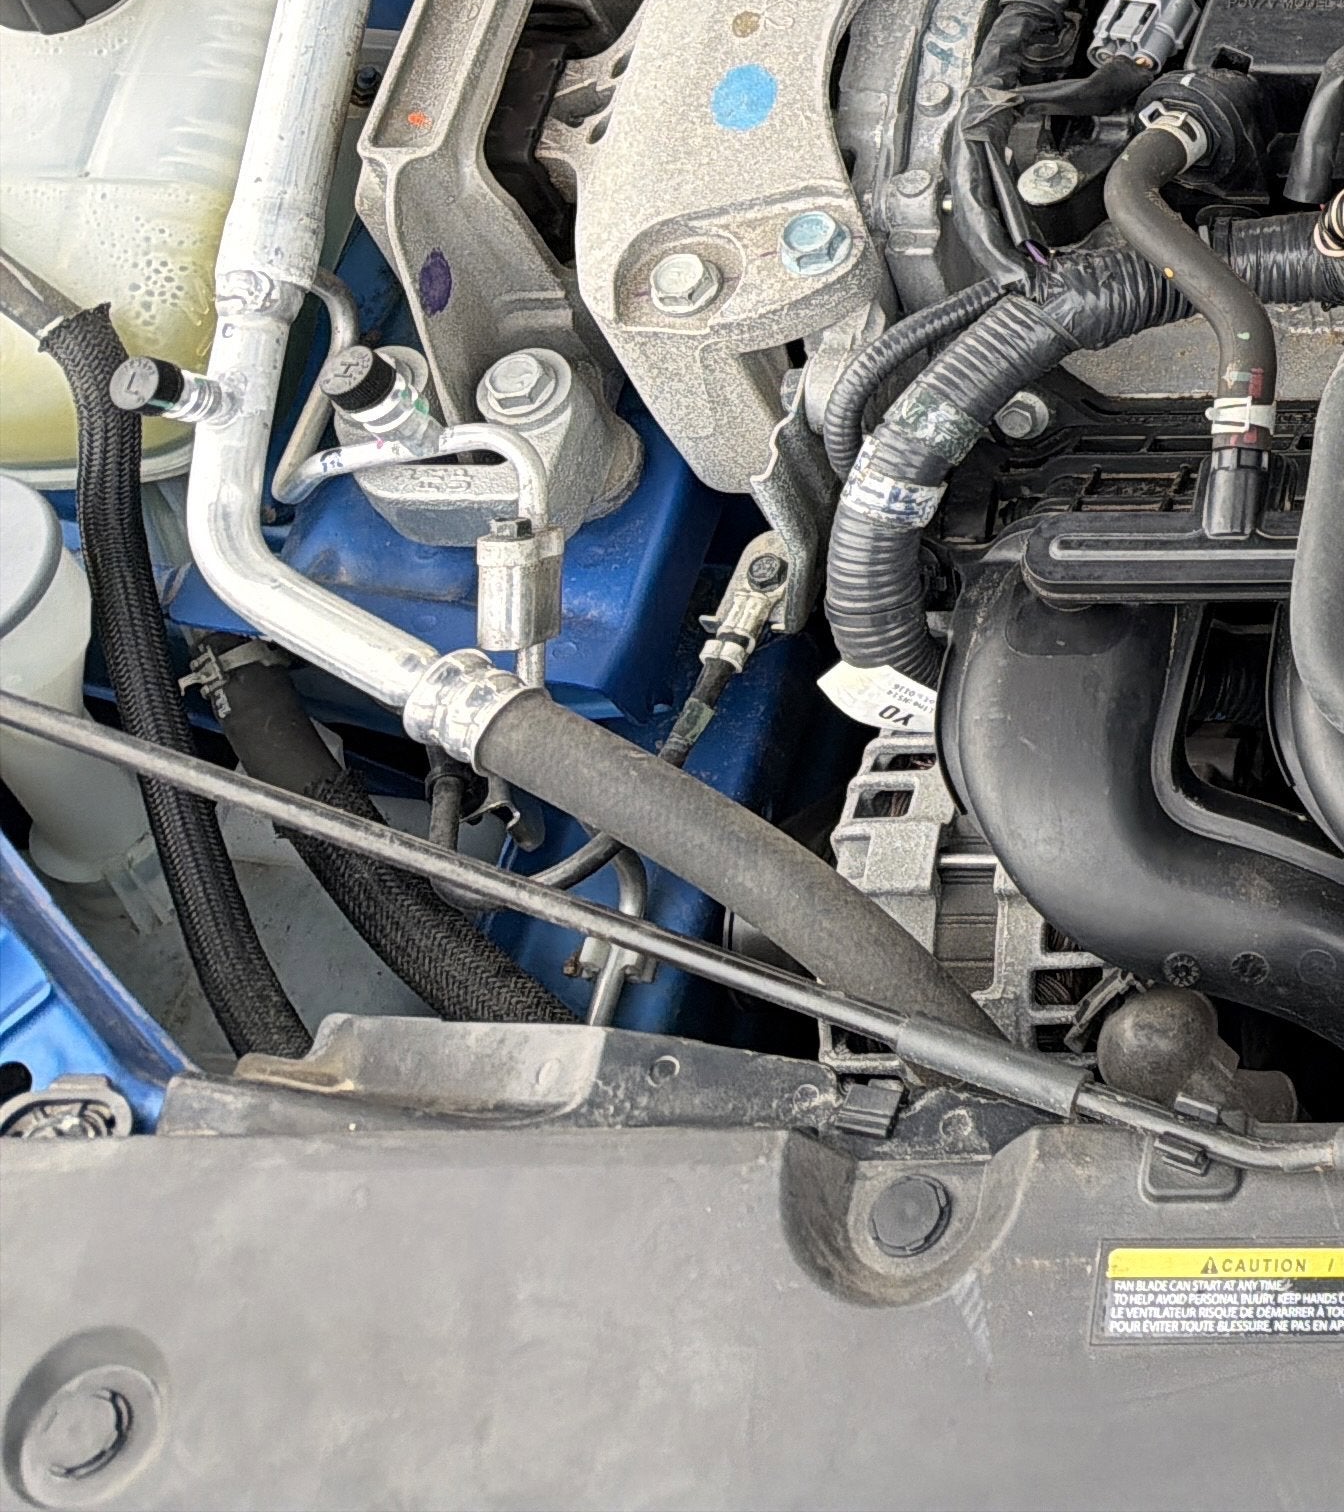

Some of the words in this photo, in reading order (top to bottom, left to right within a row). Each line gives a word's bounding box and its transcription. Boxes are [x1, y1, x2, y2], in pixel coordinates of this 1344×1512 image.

[1222, 1258, 1306, 1273] CAUTION
[1115, 1280, 1134, 1291] FAN
[1136, 1280, 1168, 1291] BLADE
[1169, 1280, 1192, 1291] CAN
[1193, 1280, 1222, 1291] START
[1223, 1280, 1237, 1291] AT
[1238, 1280, 1258, 1291] ANY
[1114, 1293, 1128, 1305] TO
[1130, 1293, 1154, 1305] HELP
[1156, 1293, 1187, 1305] AVOID
[1188, 1293, 1239, 1305] PERSONAL
[1277, 1293, 1301, 1304] KEEP
[1303, 1293, 1337, 1304] HANDS
[1111, 1307, 1125, 1318] LE
[1126, 1307, 1197, 1318] VENTILATEUR
[1199, 1307, 1238, 1319] RISQUE
[1239, 1307, 1254, 1318] DE
[1110, 1320, 1141, 1332] POUR
[1180, 1320, 1216, 1332] TOUTE
[1274, 1320, 1288, 1332] NE
[1290, 1320, 1311, 1331] PAS
[1312, 1320, 1328, 1331] EN
